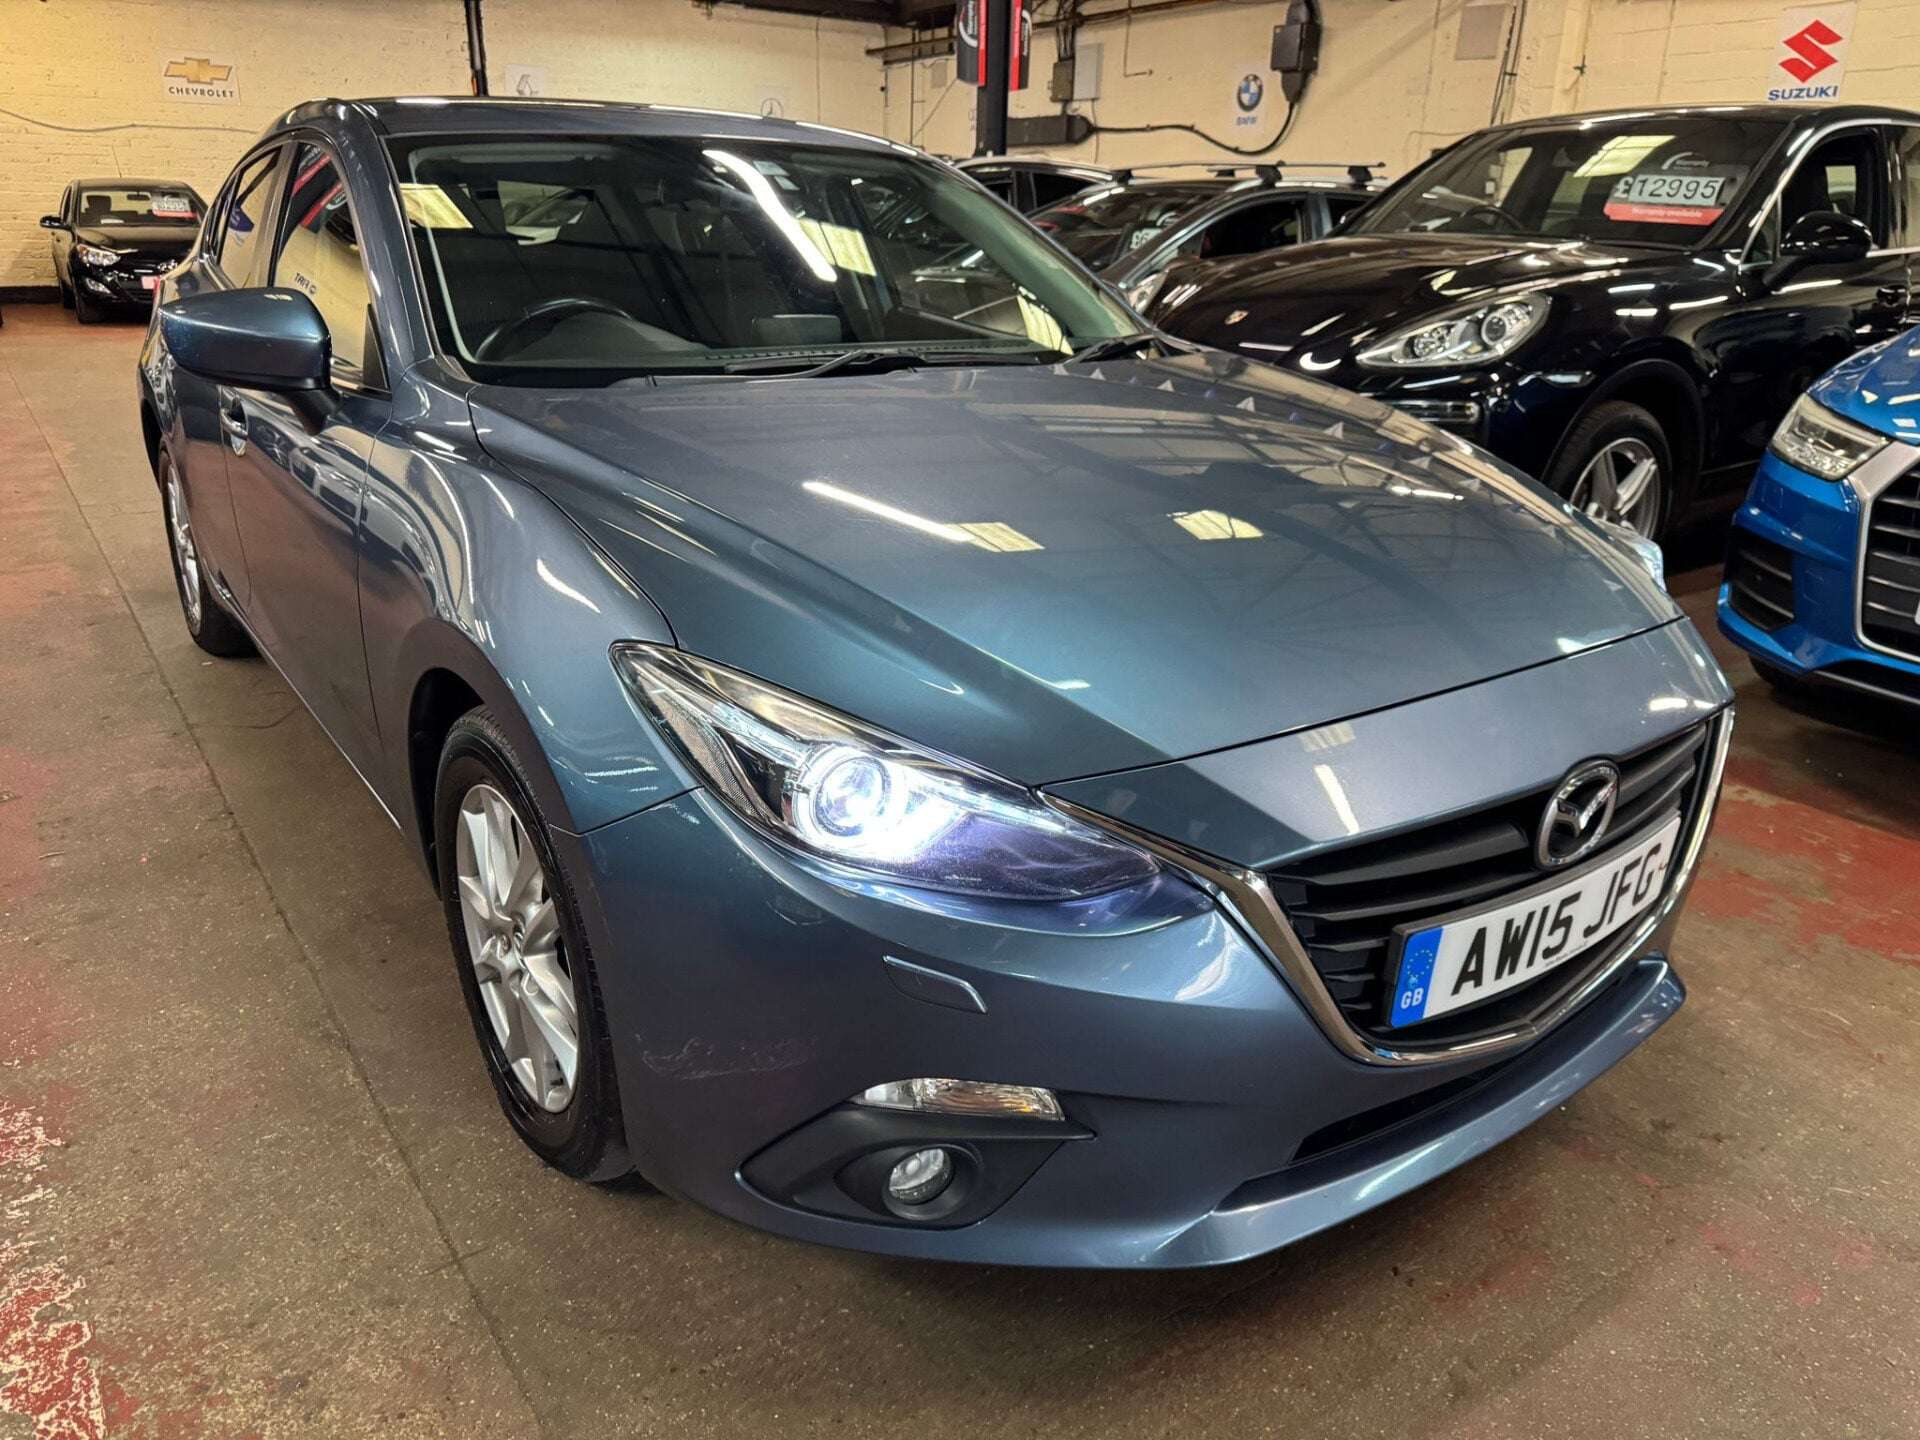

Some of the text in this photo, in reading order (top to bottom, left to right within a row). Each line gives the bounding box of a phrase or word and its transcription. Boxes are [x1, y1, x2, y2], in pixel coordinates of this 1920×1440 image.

[168, 86, 234, 98] CHEVROLET
[1767, 85, 1839, 101] SUZUKI
[1613, 176, 1720, 200] £12995
[1451, 842, 1662, 996] AW15 JFG
[1400, 987, 1424, 1010] GB
